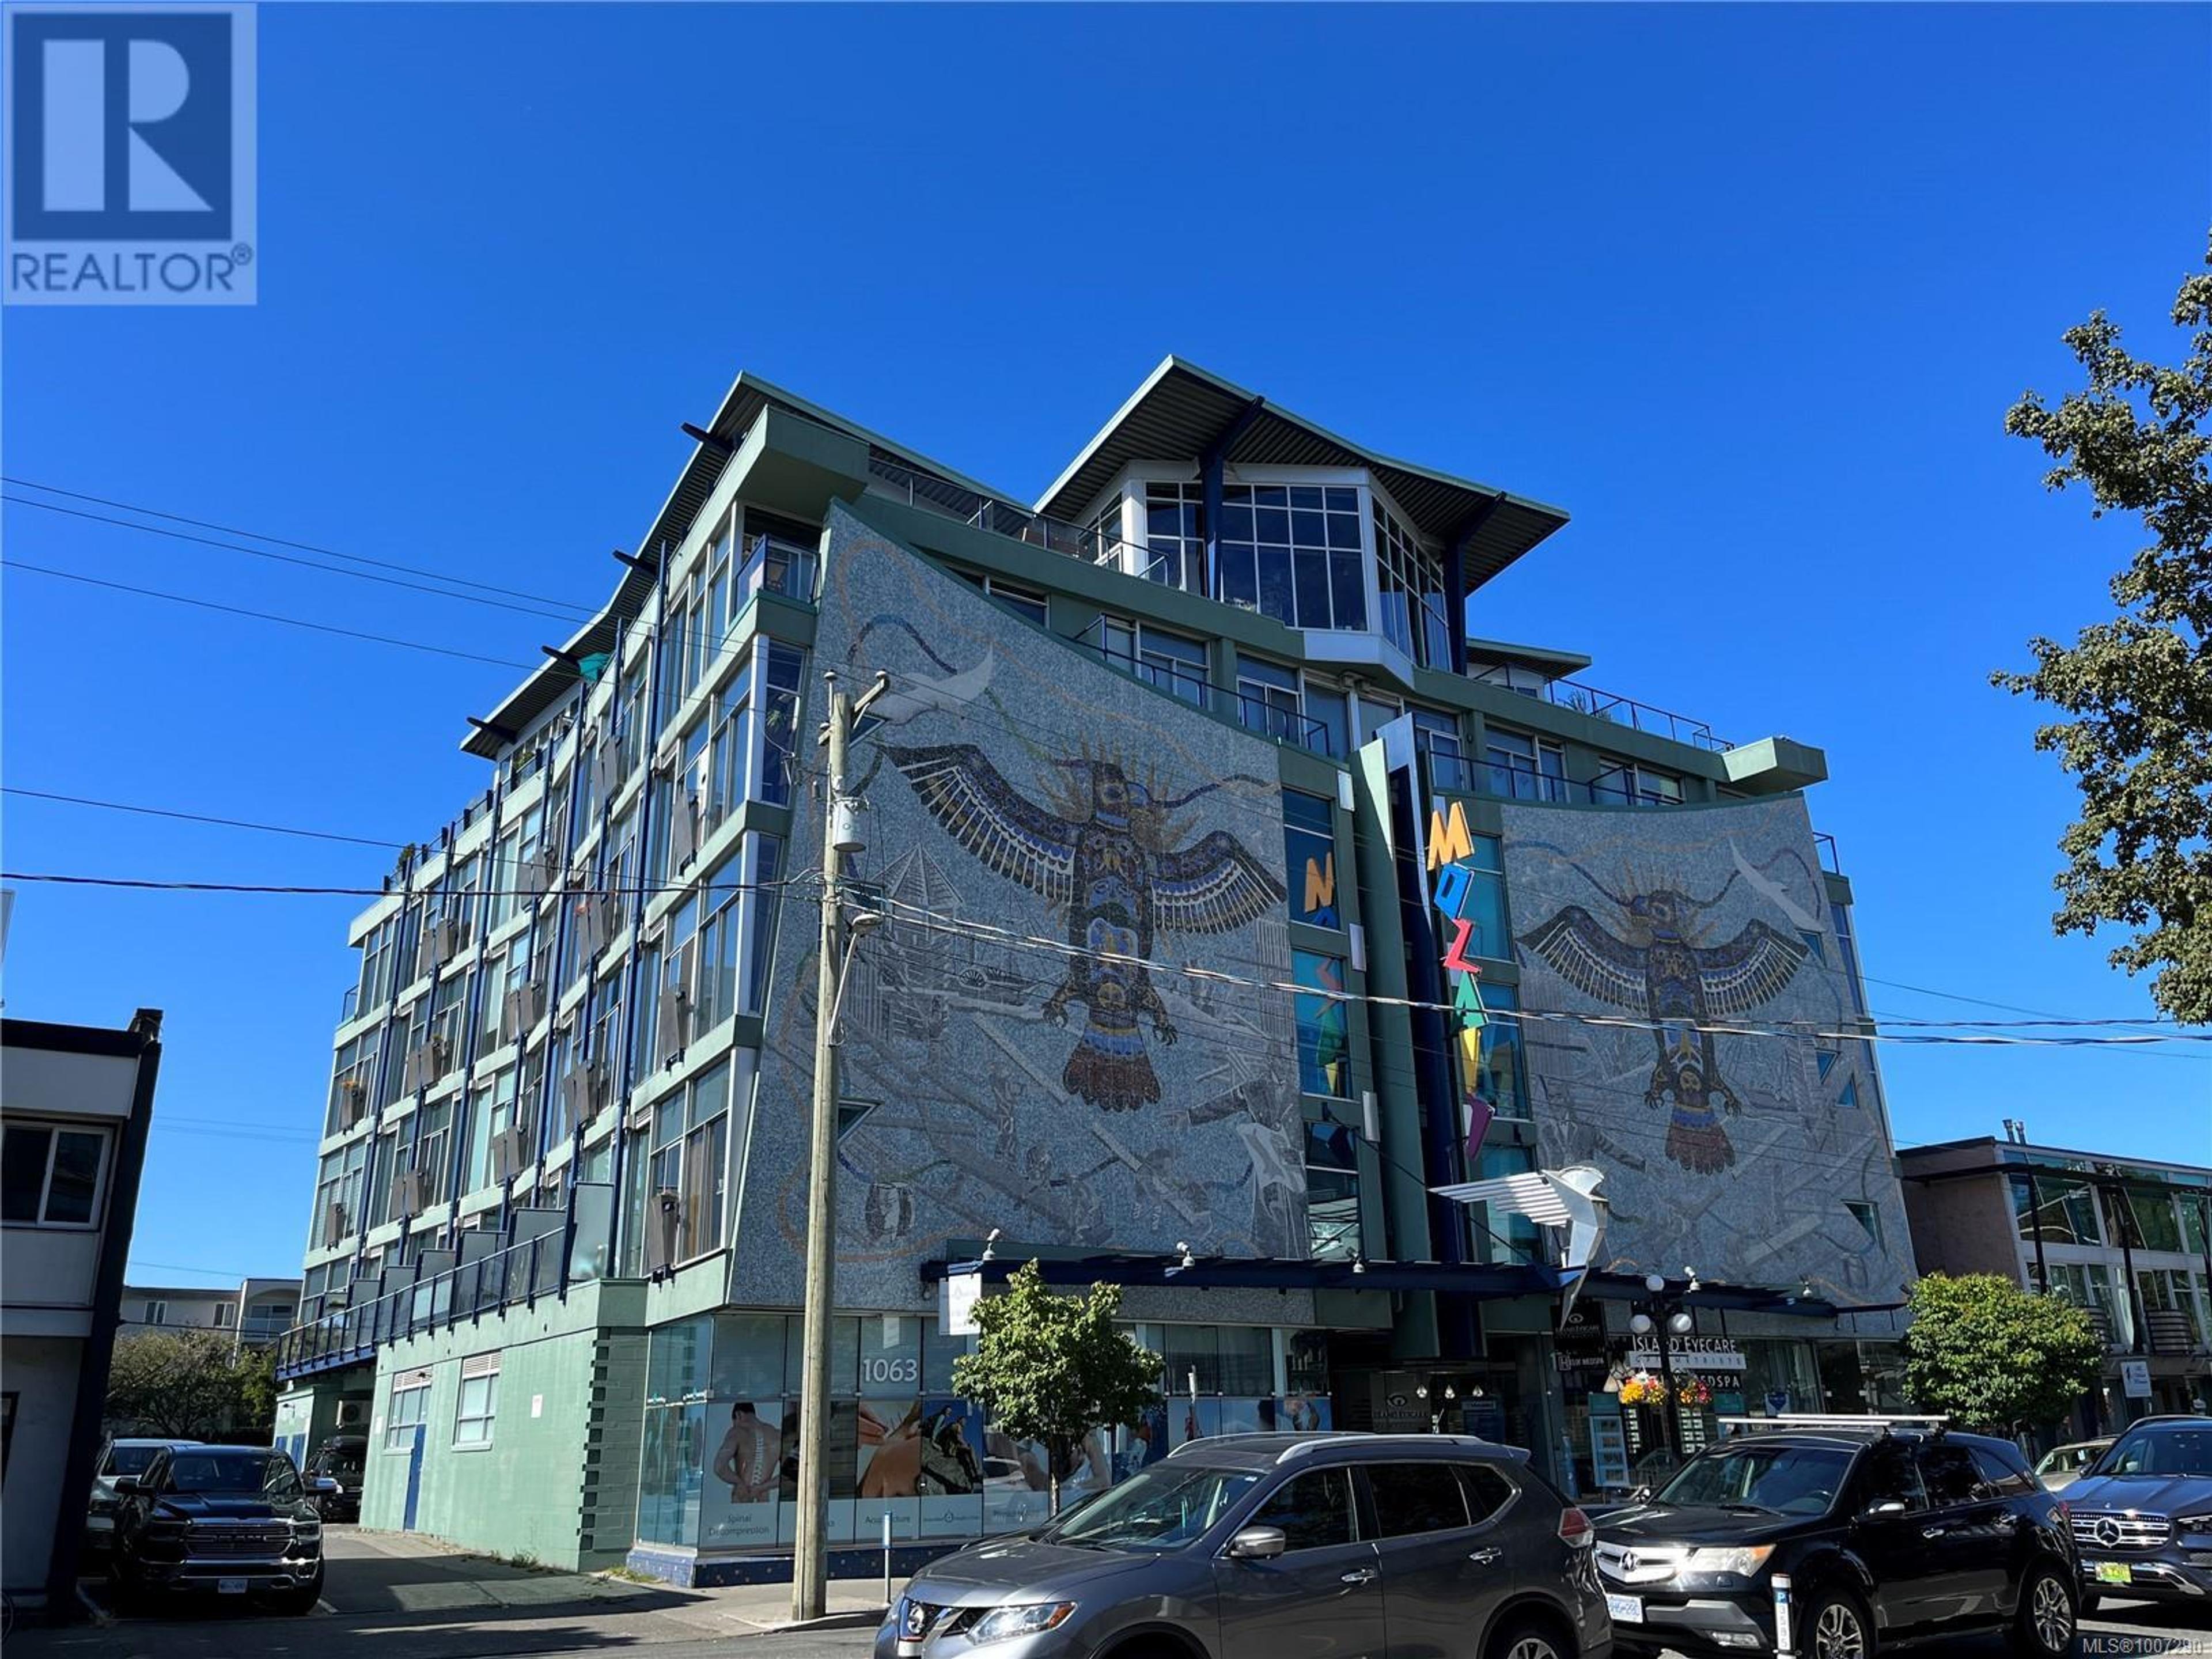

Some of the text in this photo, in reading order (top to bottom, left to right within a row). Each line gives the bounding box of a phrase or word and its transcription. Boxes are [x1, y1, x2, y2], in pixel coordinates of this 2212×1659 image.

[1633, 1334, 1736, 1354] ISLAD EYECARE
[863, 1359, 917, 1382] 1063
[728, 1514, 752, 1524] Spinal
